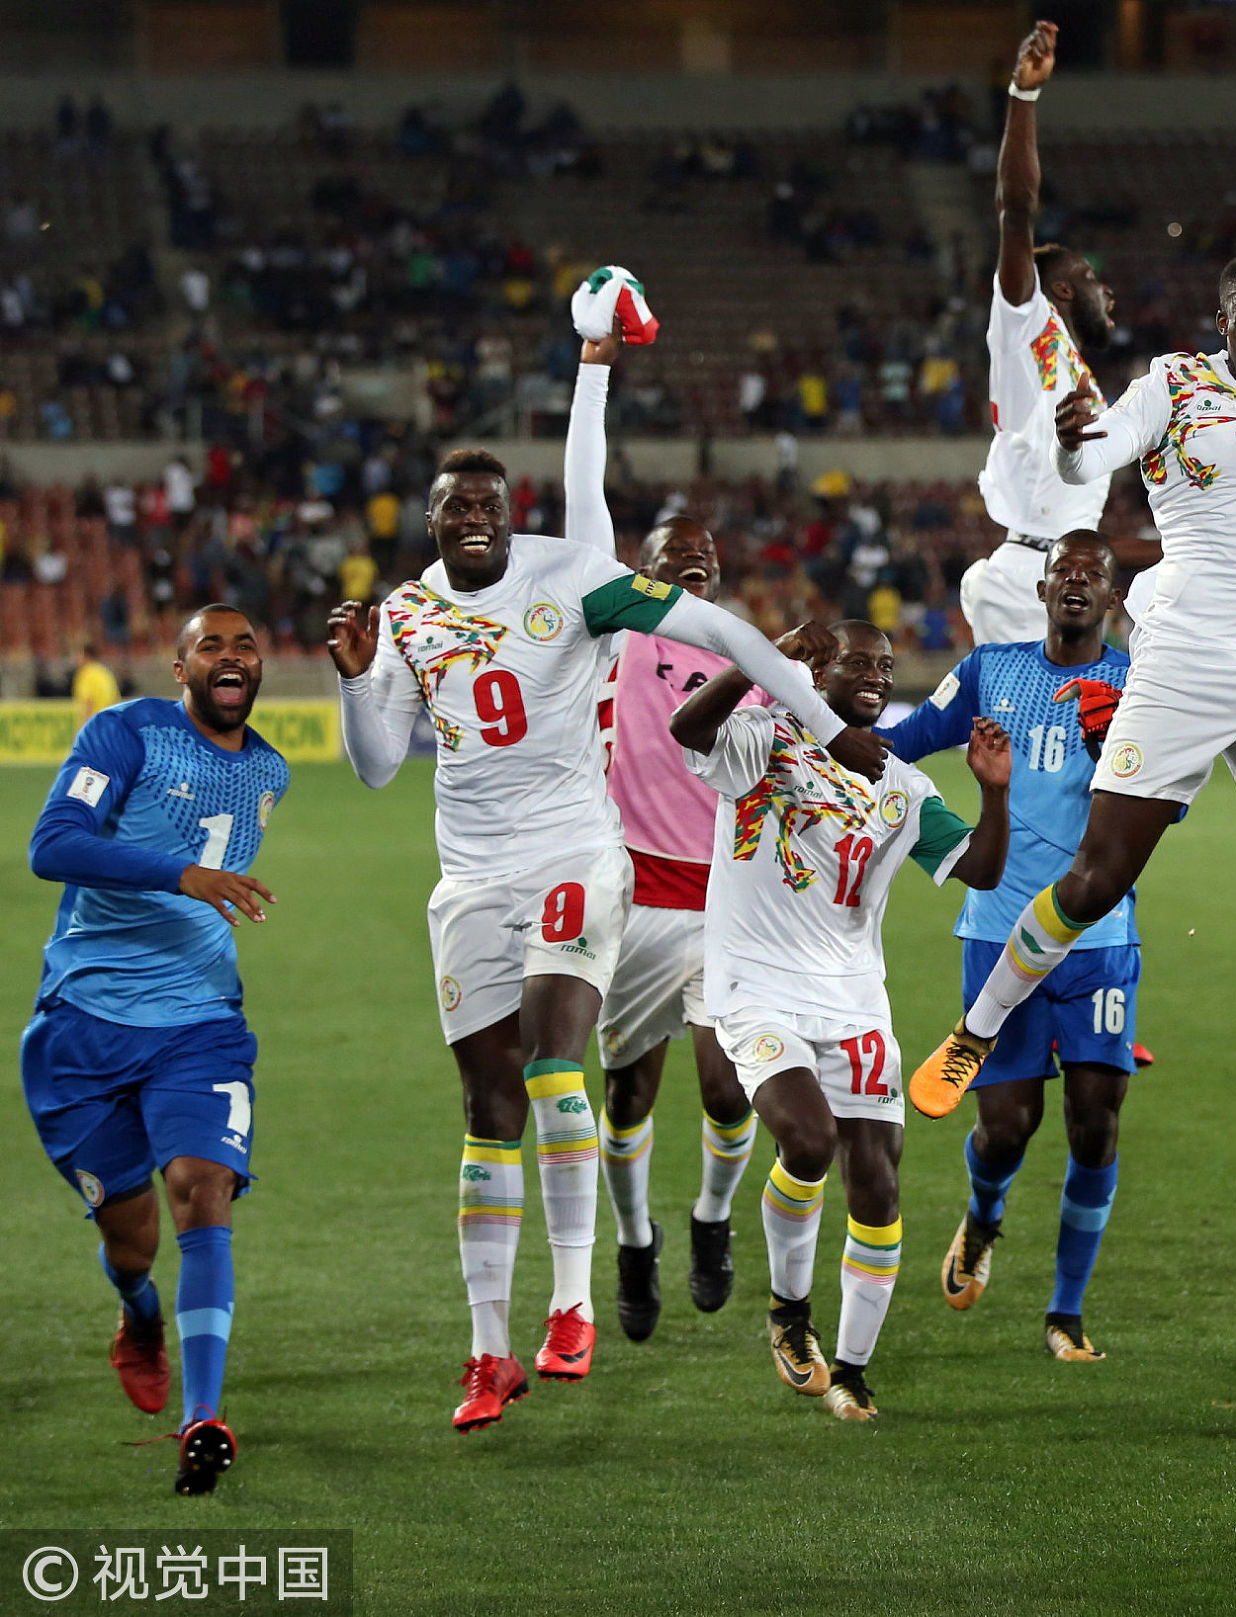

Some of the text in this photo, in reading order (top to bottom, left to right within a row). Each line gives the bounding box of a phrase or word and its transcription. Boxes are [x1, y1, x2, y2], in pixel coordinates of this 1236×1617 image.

[473, 669, 528, 747] 9
[1028, 724, 1067, 773] 16
[199, 813, 234, 870] 1
[833, 833, 874, 907] 12
[542, 882, 586, 943] 9
[1092, 988, 1126, 1035] 16
[840, 1029, 889, 1096] 12
[212, 1081, 252, 1138] 1
